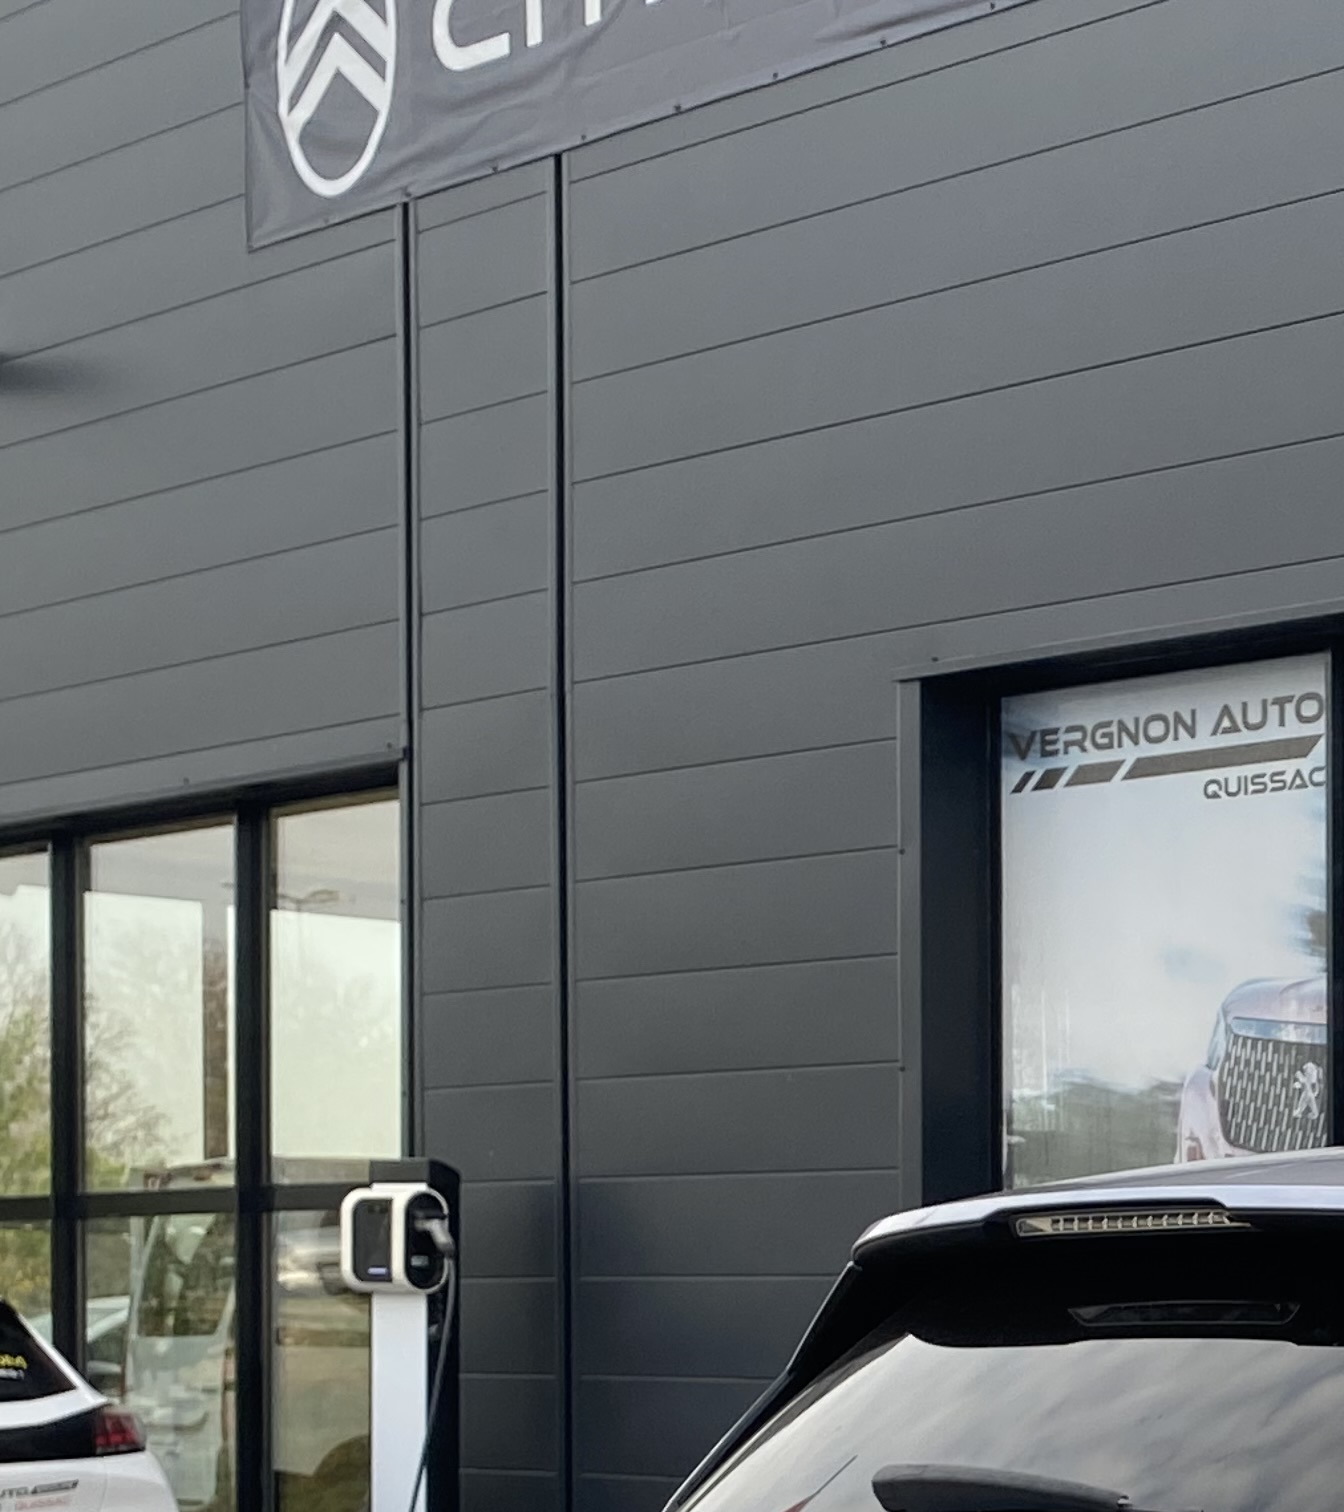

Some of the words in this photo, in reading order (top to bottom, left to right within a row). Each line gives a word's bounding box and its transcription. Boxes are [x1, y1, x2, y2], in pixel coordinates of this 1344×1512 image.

[1008, 707, 1197, 761] VERGNON
[1210, 691, 1325, 737] AUTO
[1203, 765, 1326, 800] QUISSAC
